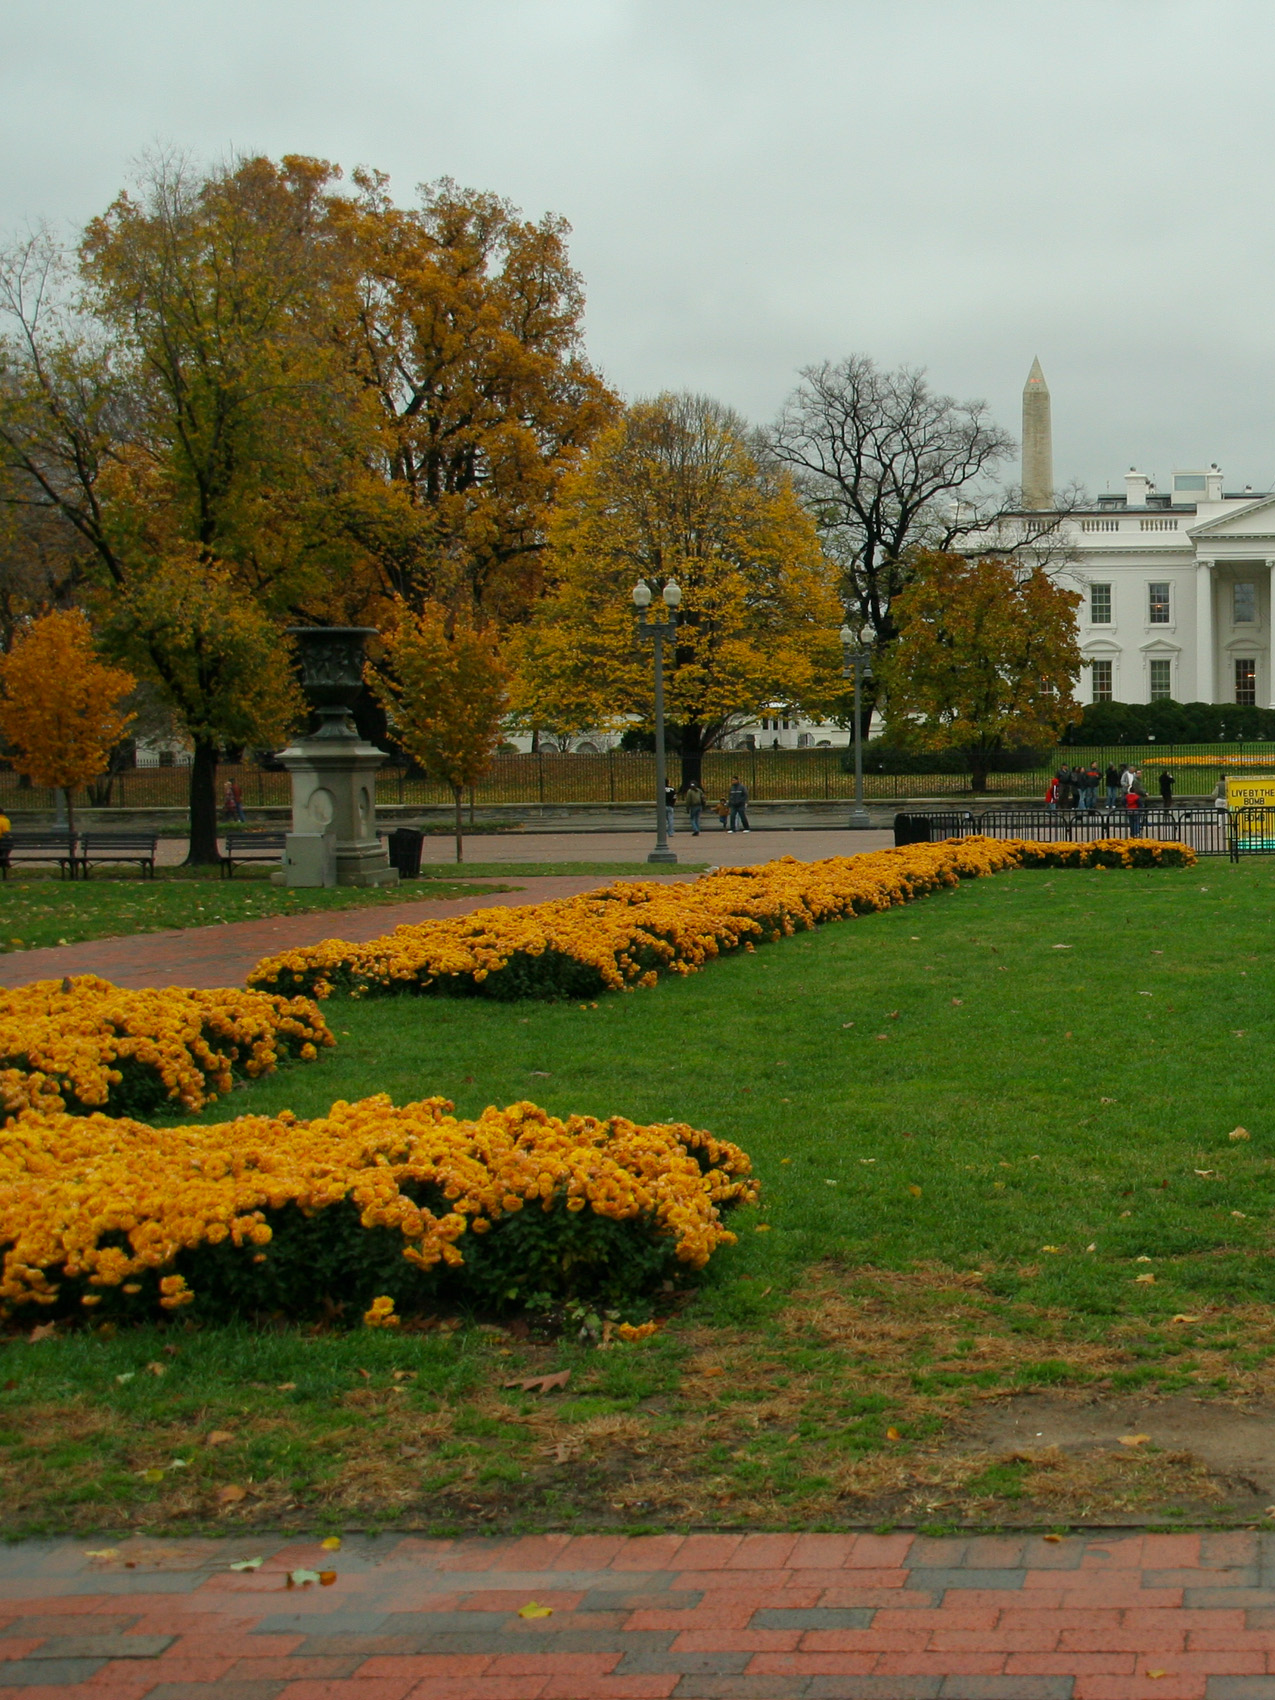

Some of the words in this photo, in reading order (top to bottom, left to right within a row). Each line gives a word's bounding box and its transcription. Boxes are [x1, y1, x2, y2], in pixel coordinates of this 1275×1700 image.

[1231, 789, 1247, 797] LIVE
[1249, 789, 1258, 797] BY
[1260, 789, 1275, 797] THE
